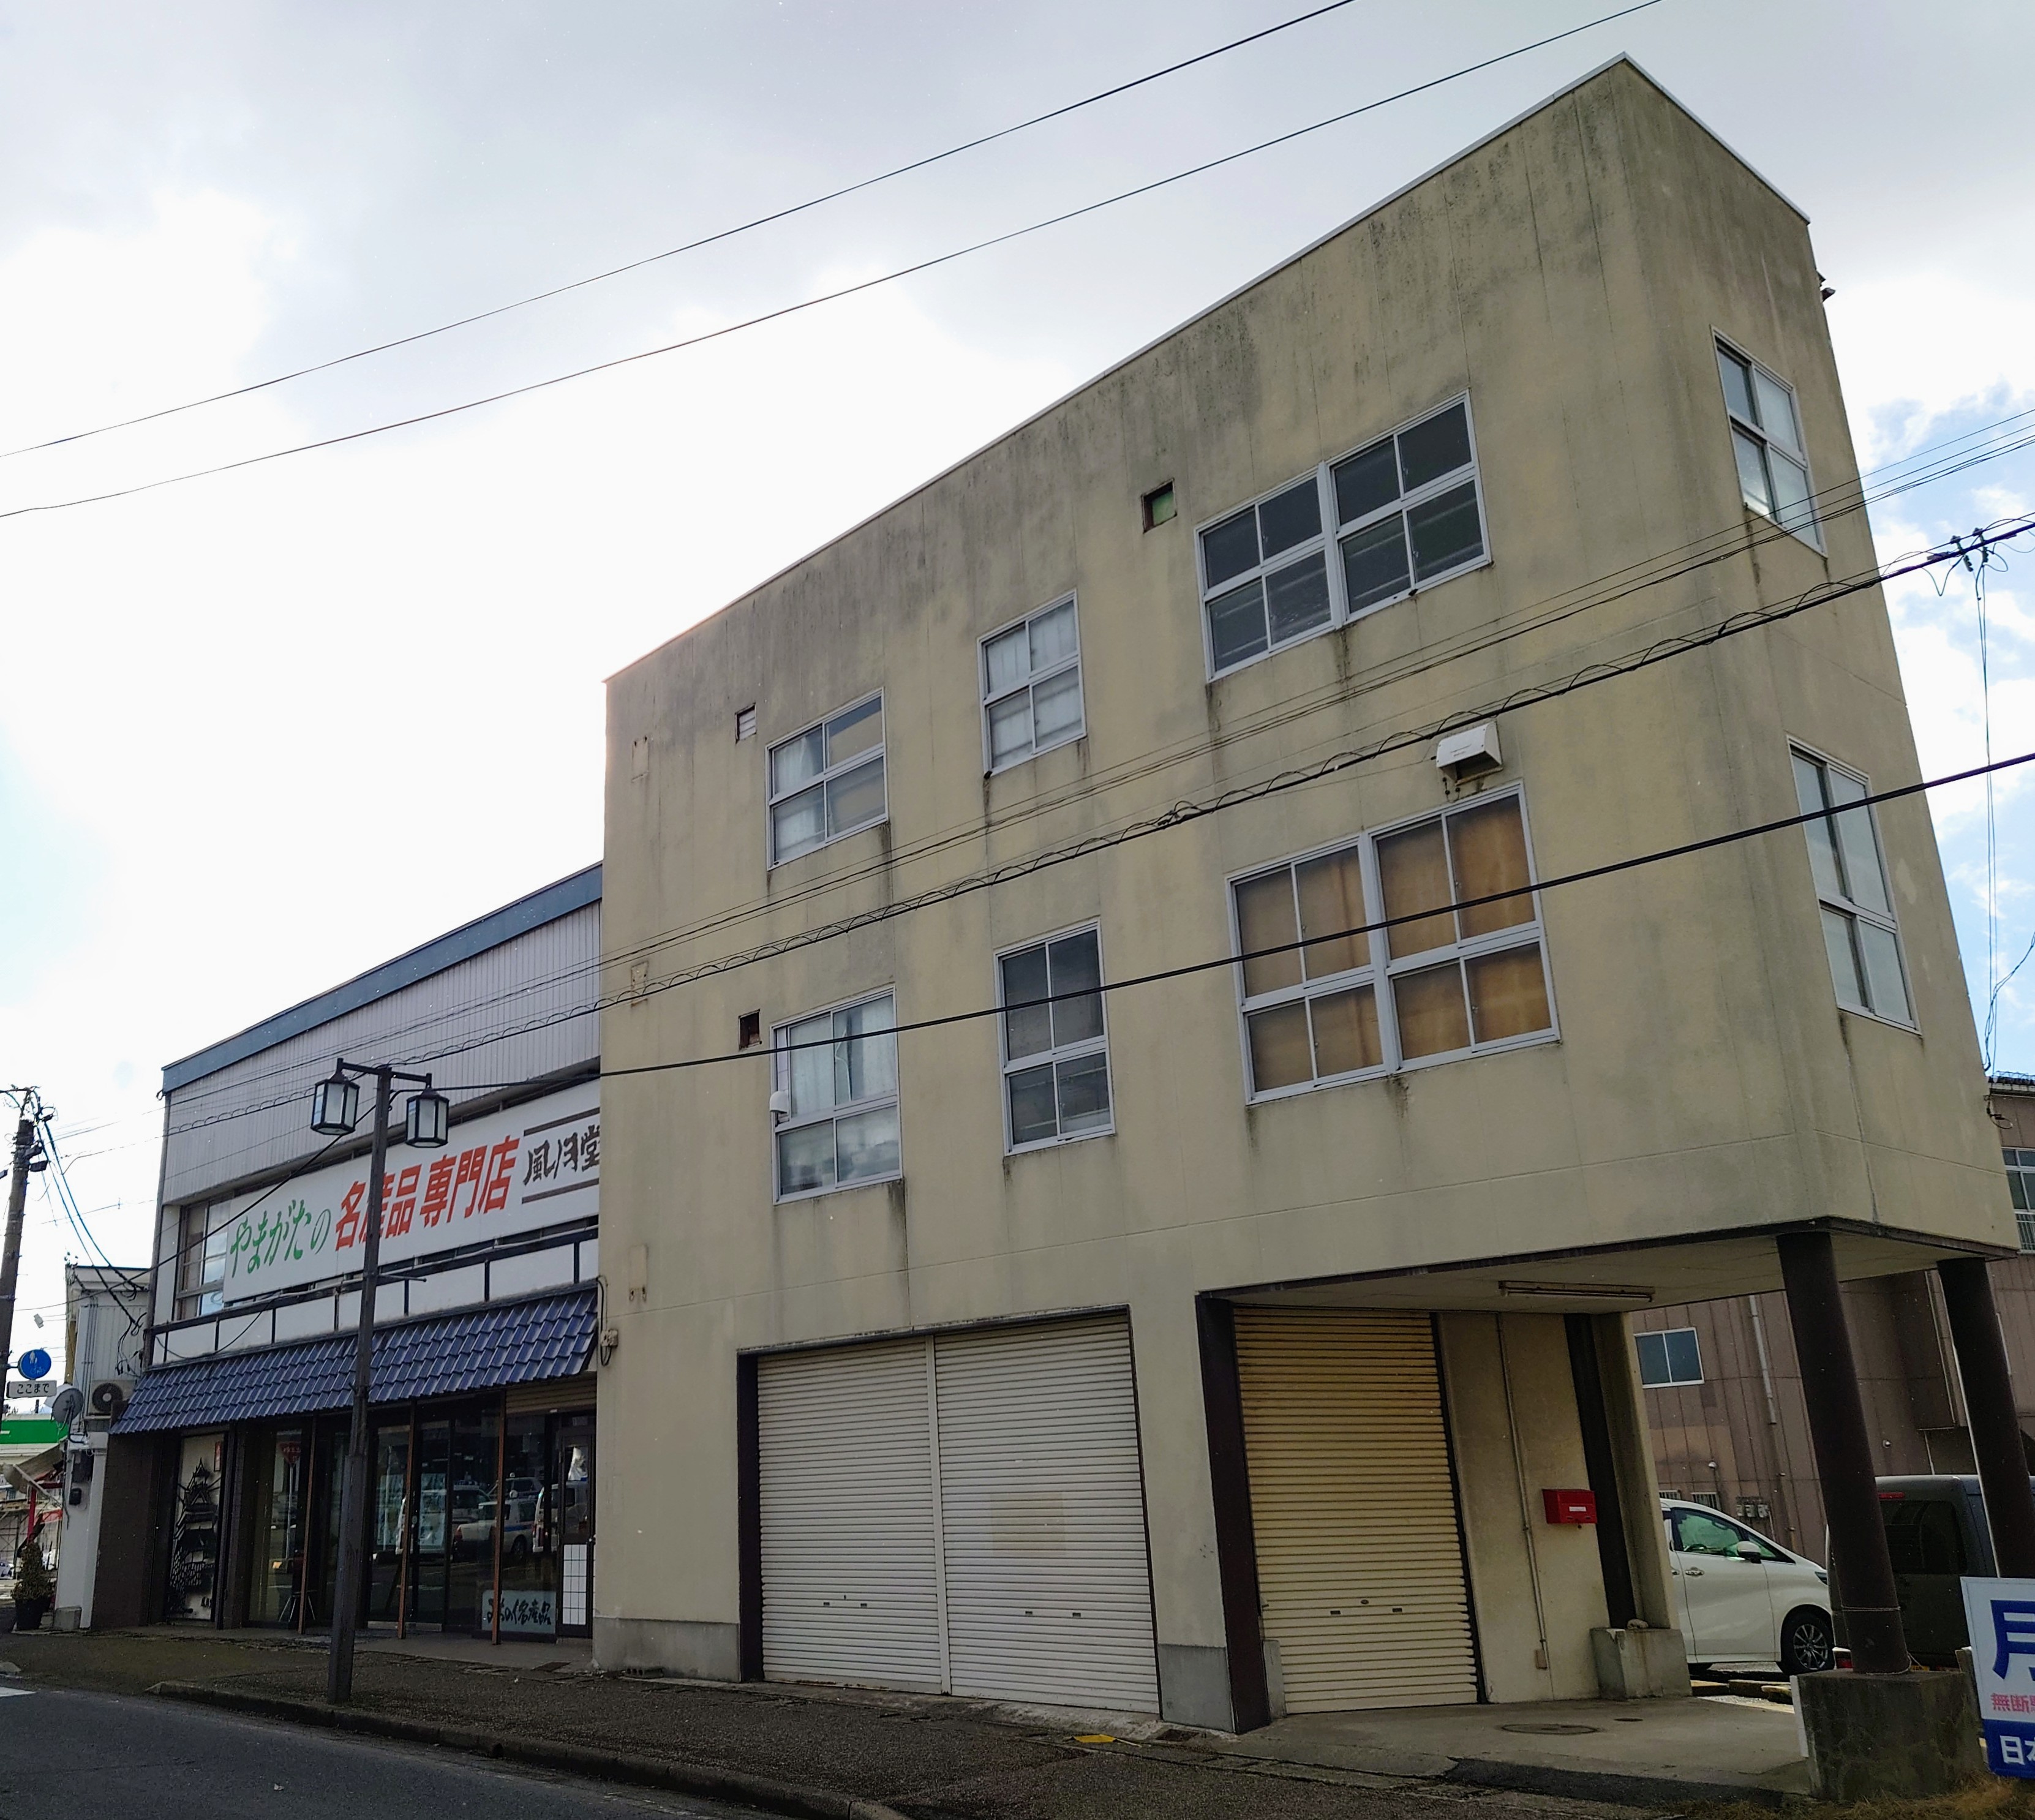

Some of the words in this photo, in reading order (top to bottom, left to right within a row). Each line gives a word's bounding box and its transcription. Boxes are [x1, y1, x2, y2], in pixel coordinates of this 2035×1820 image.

[523, 1124, 600, 1186] 風月堂
[17, 1383, 50, 1394] ここまで
